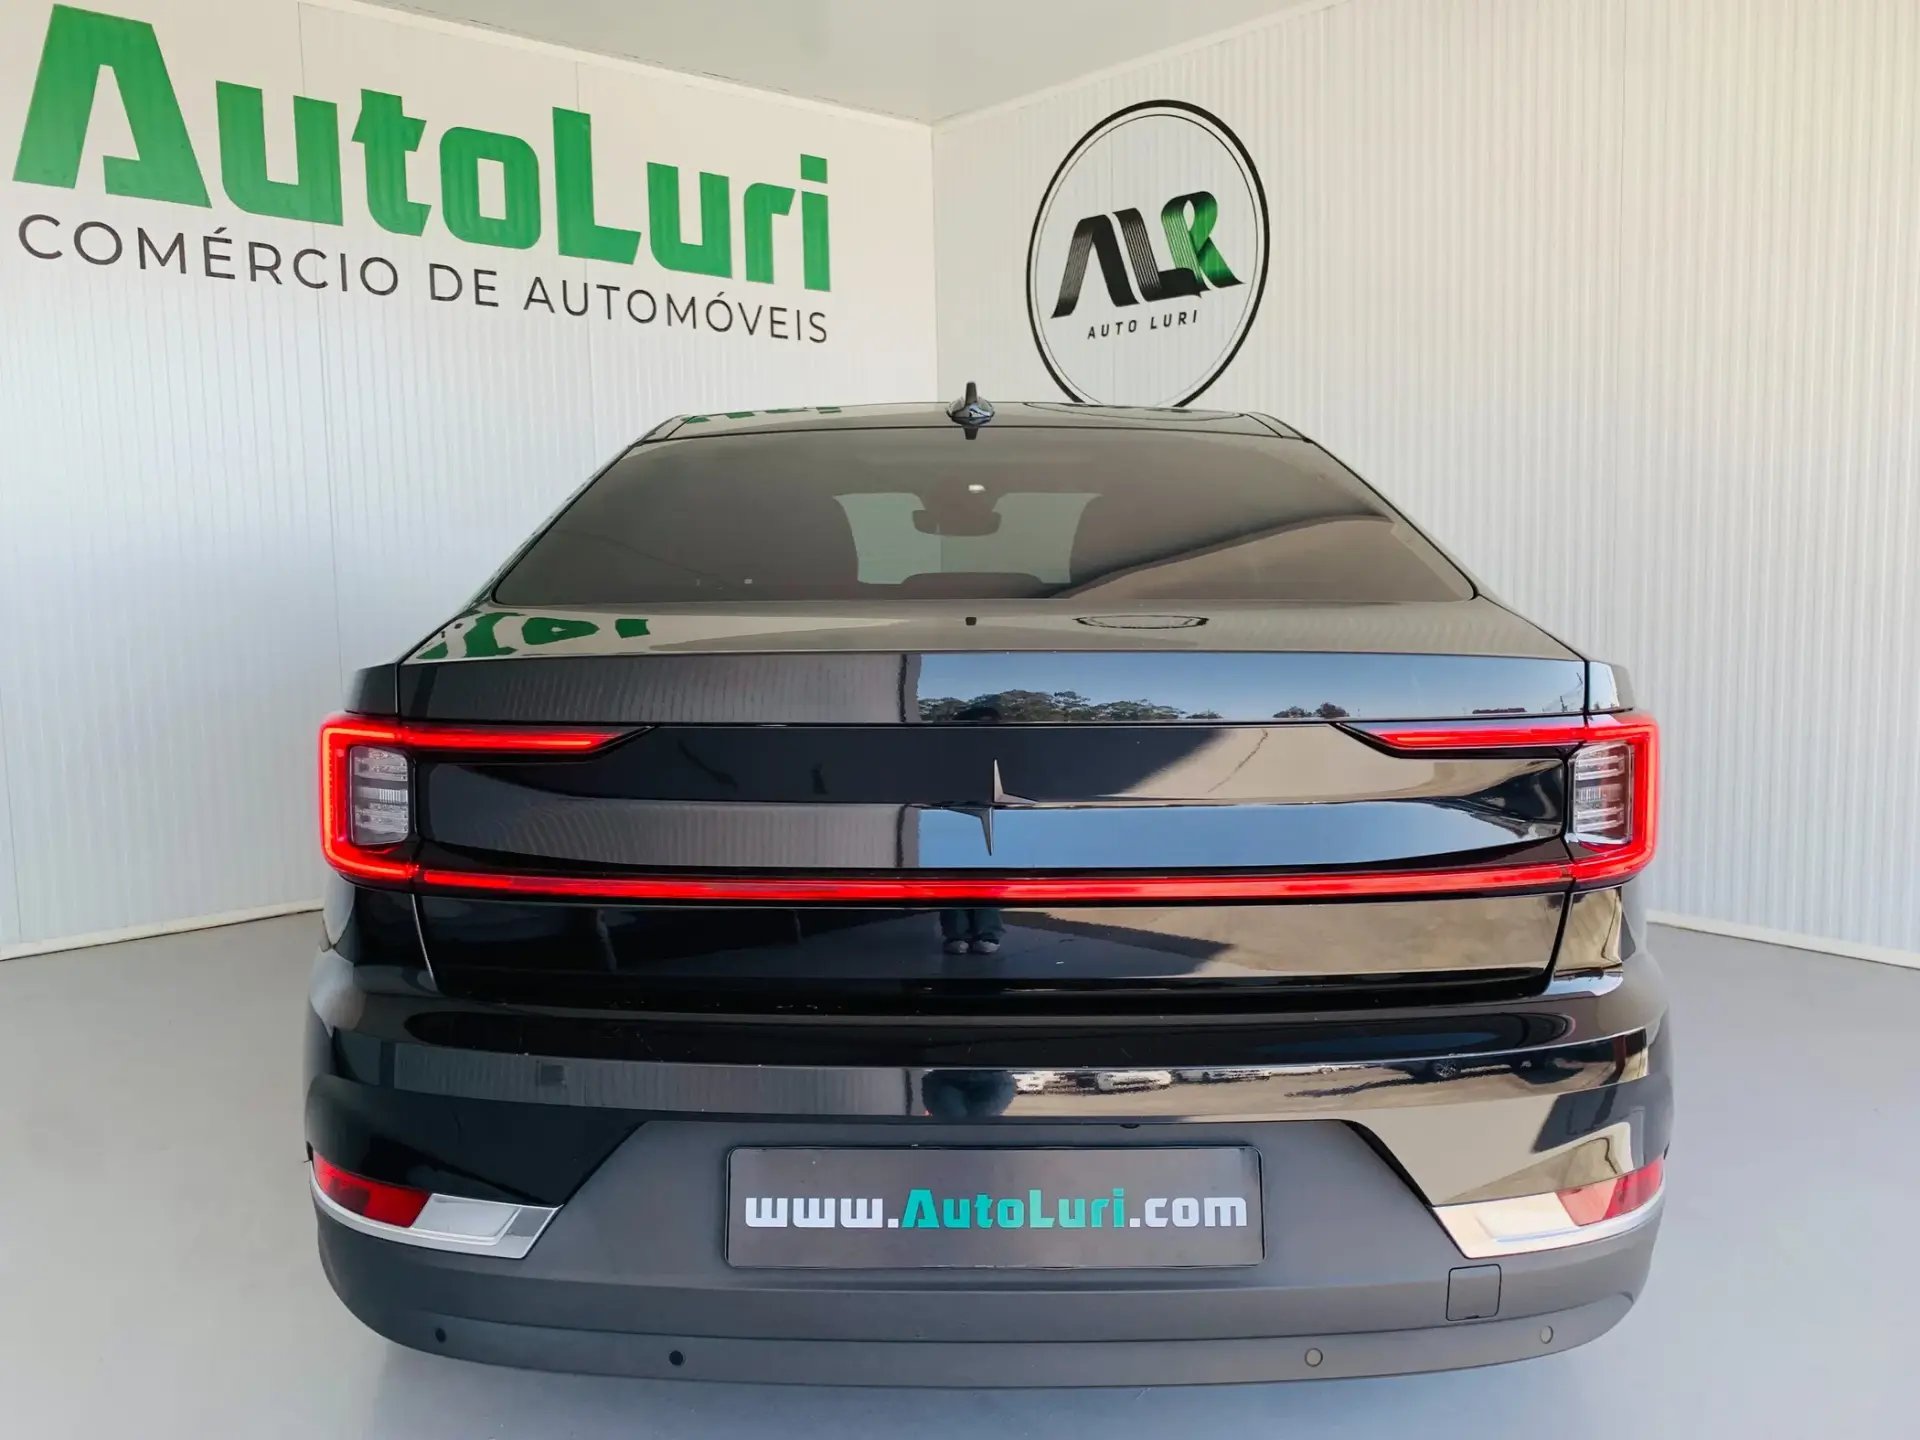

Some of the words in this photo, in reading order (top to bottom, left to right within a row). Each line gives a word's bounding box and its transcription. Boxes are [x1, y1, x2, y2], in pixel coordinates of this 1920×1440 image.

[13, 4, 831, 292] AutoLuri
[17, 213, 400, 297] COMÉRCIO
[428, 263, 500, 309] DE
[523, 276, 829, 345] AUTOMÓVEIS
[1087, 319, 1137, 340] AUTO
[1150, 309, 1198, 330] LURI
[745, 1187, 1248, 1229] www.AutoLuri.com
